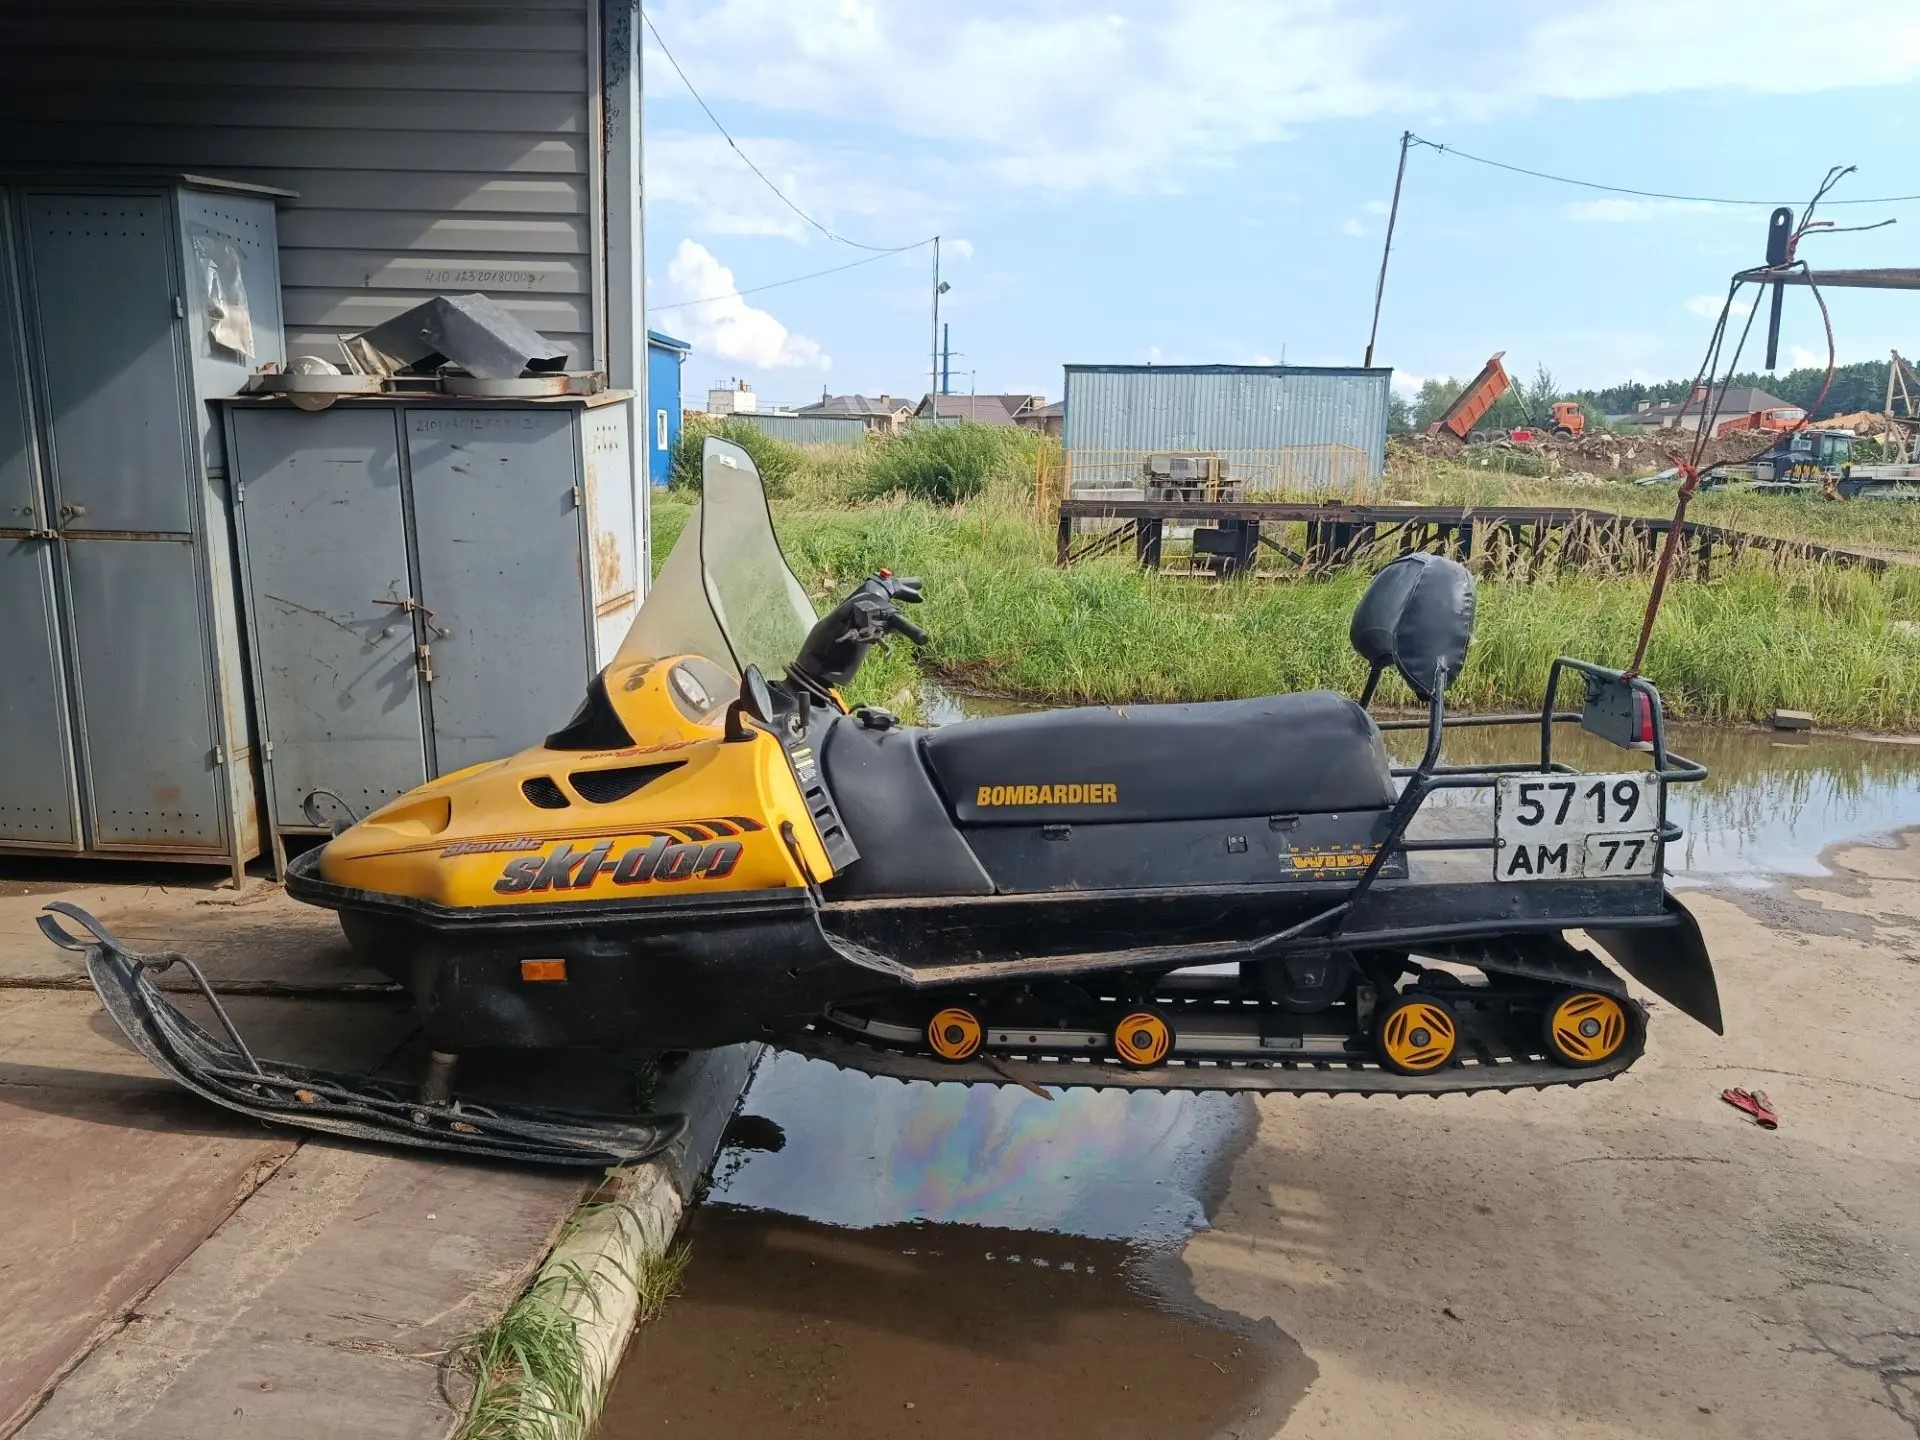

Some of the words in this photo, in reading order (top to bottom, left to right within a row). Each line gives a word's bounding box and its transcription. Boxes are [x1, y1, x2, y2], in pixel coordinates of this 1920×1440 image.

[976, 783, 1118, 806] BOMBARDIER
[1516, 779, 1640, 827] 5719
[1599, 839, 1646, 872] 77
